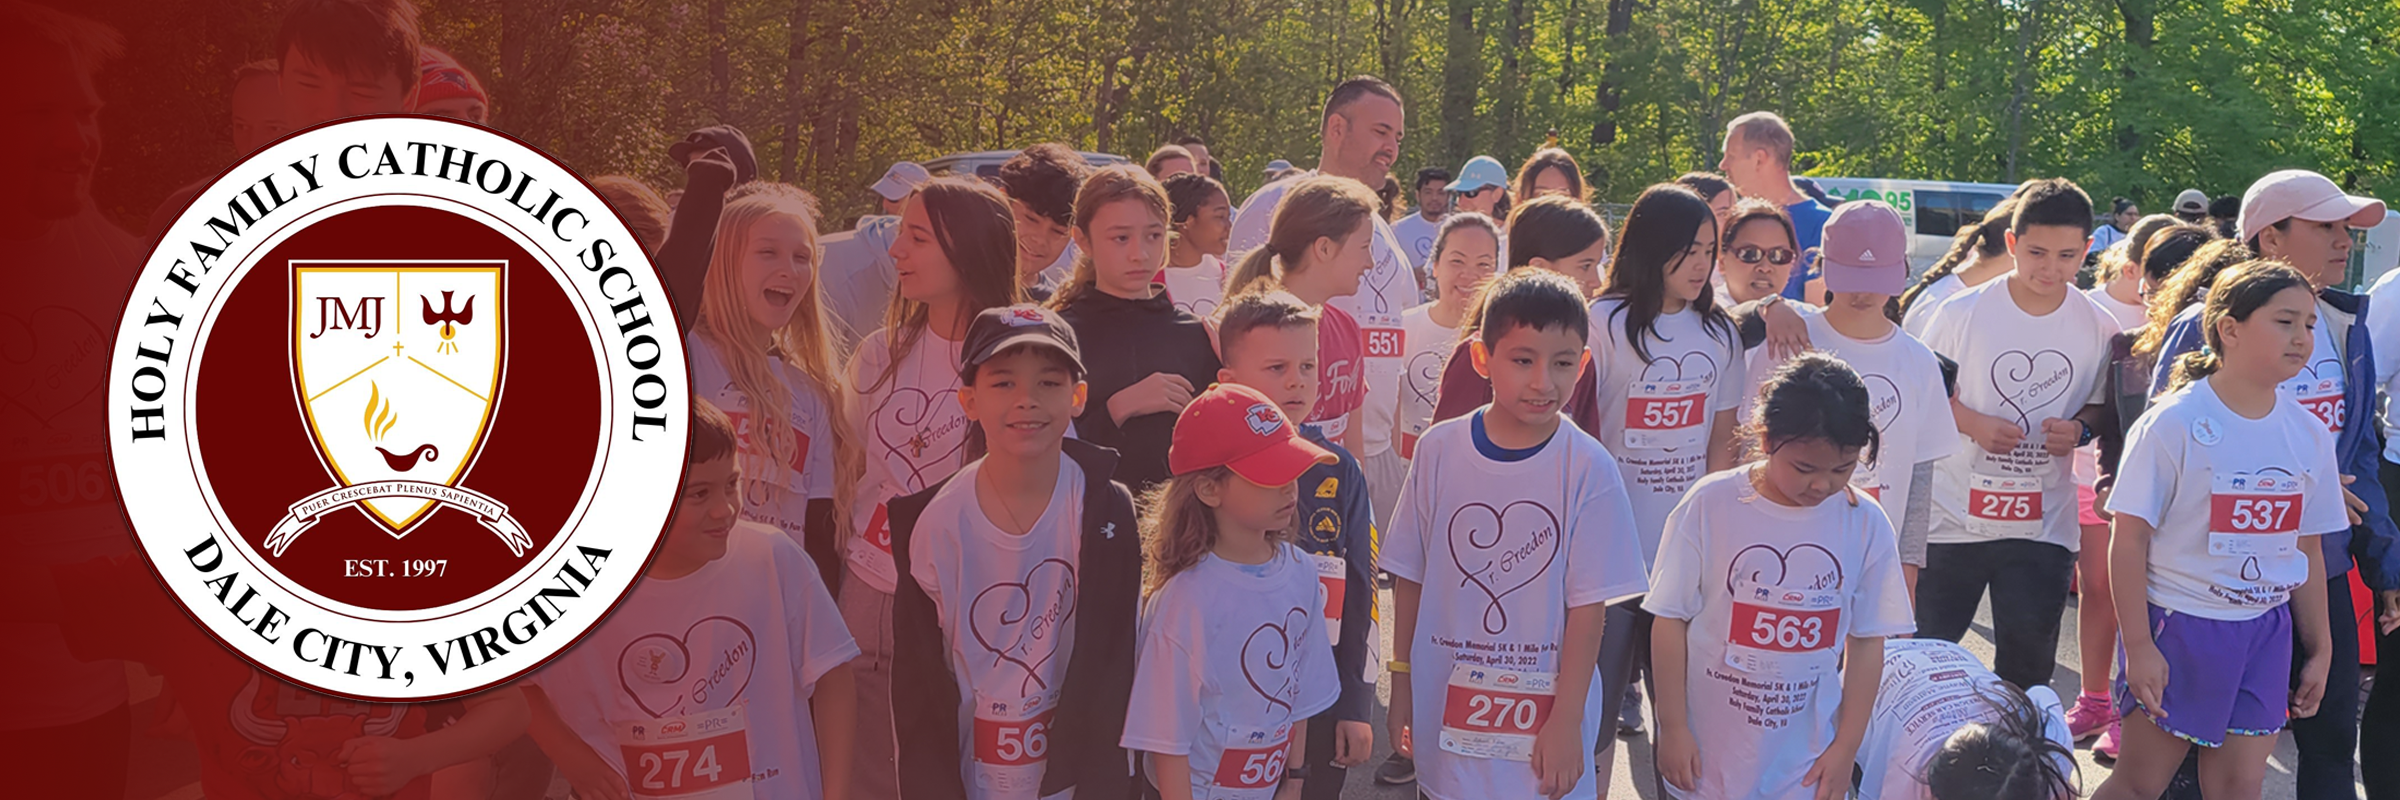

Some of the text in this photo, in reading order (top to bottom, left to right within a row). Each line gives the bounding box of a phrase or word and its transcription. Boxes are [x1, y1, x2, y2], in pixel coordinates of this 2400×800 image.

[1368, 331, 1399, 355] 551
[1643, 399, 1694, 427] 557
[18, 461, 106, 507] 506
[1981, 494, 2030, 518] 275
[2231, 499, 2292, 531] 537
[1751, 611, 1822, 648] 563
[1466, 694, 1537, 730] 270
[997, 716, 1054, 761] 56
[639, 745, 722, 789] 274
